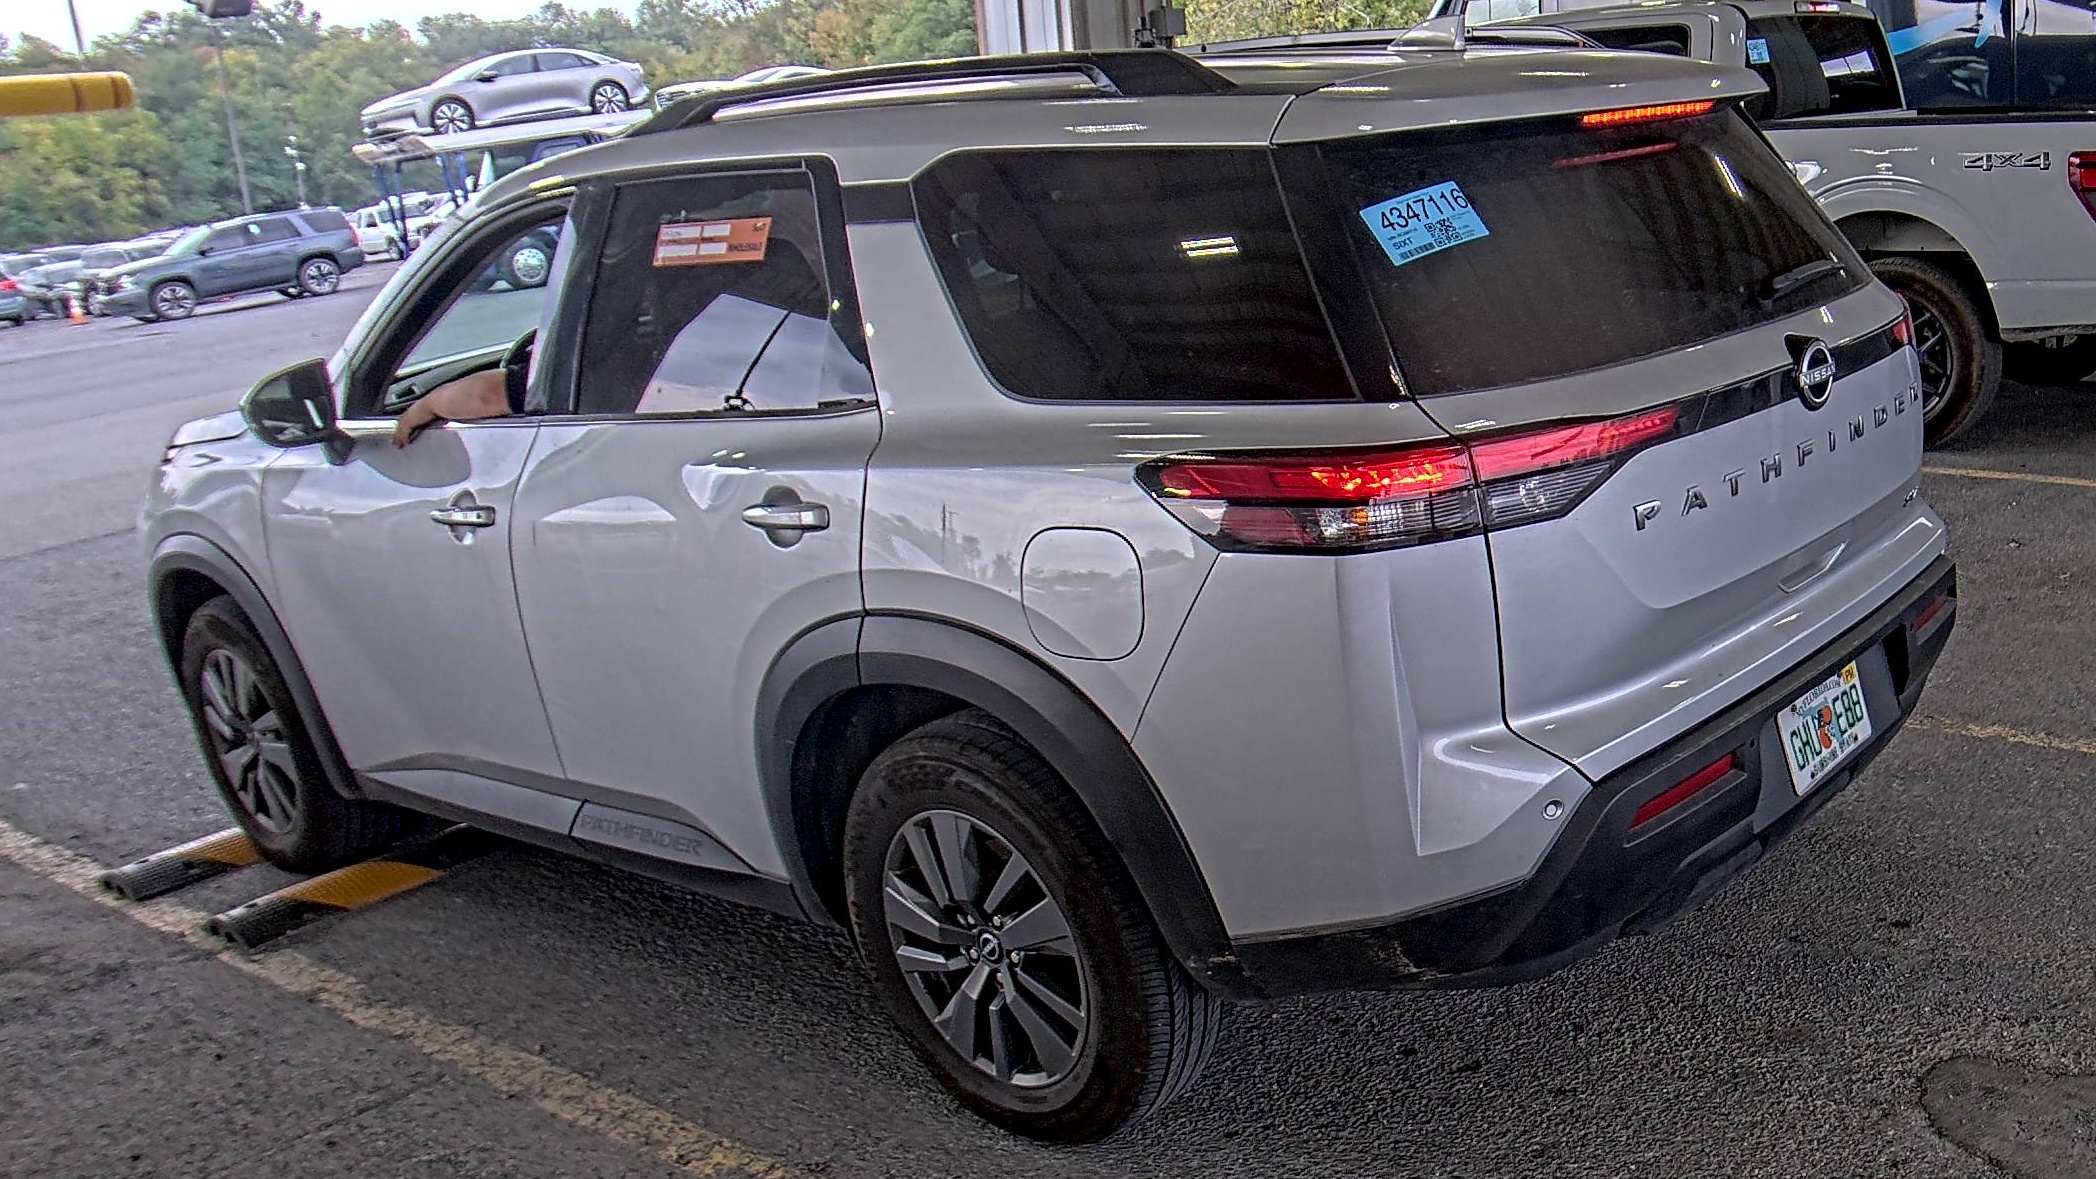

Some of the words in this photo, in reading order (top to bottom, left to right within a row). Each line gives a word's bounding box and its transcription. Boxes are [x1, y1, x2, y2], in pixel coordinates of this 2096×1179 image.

[1380, 188, 1469, 231] 4347116
[1392, 237, 1414, 250] SIXT
[1800, 362, 1836, 387] NISSAN
[1632, 384, 1920, 531] PATHFINDER
[1790, 714, 1823, 771] GHU
[579, 813, 702, 855] PATHFINDER
